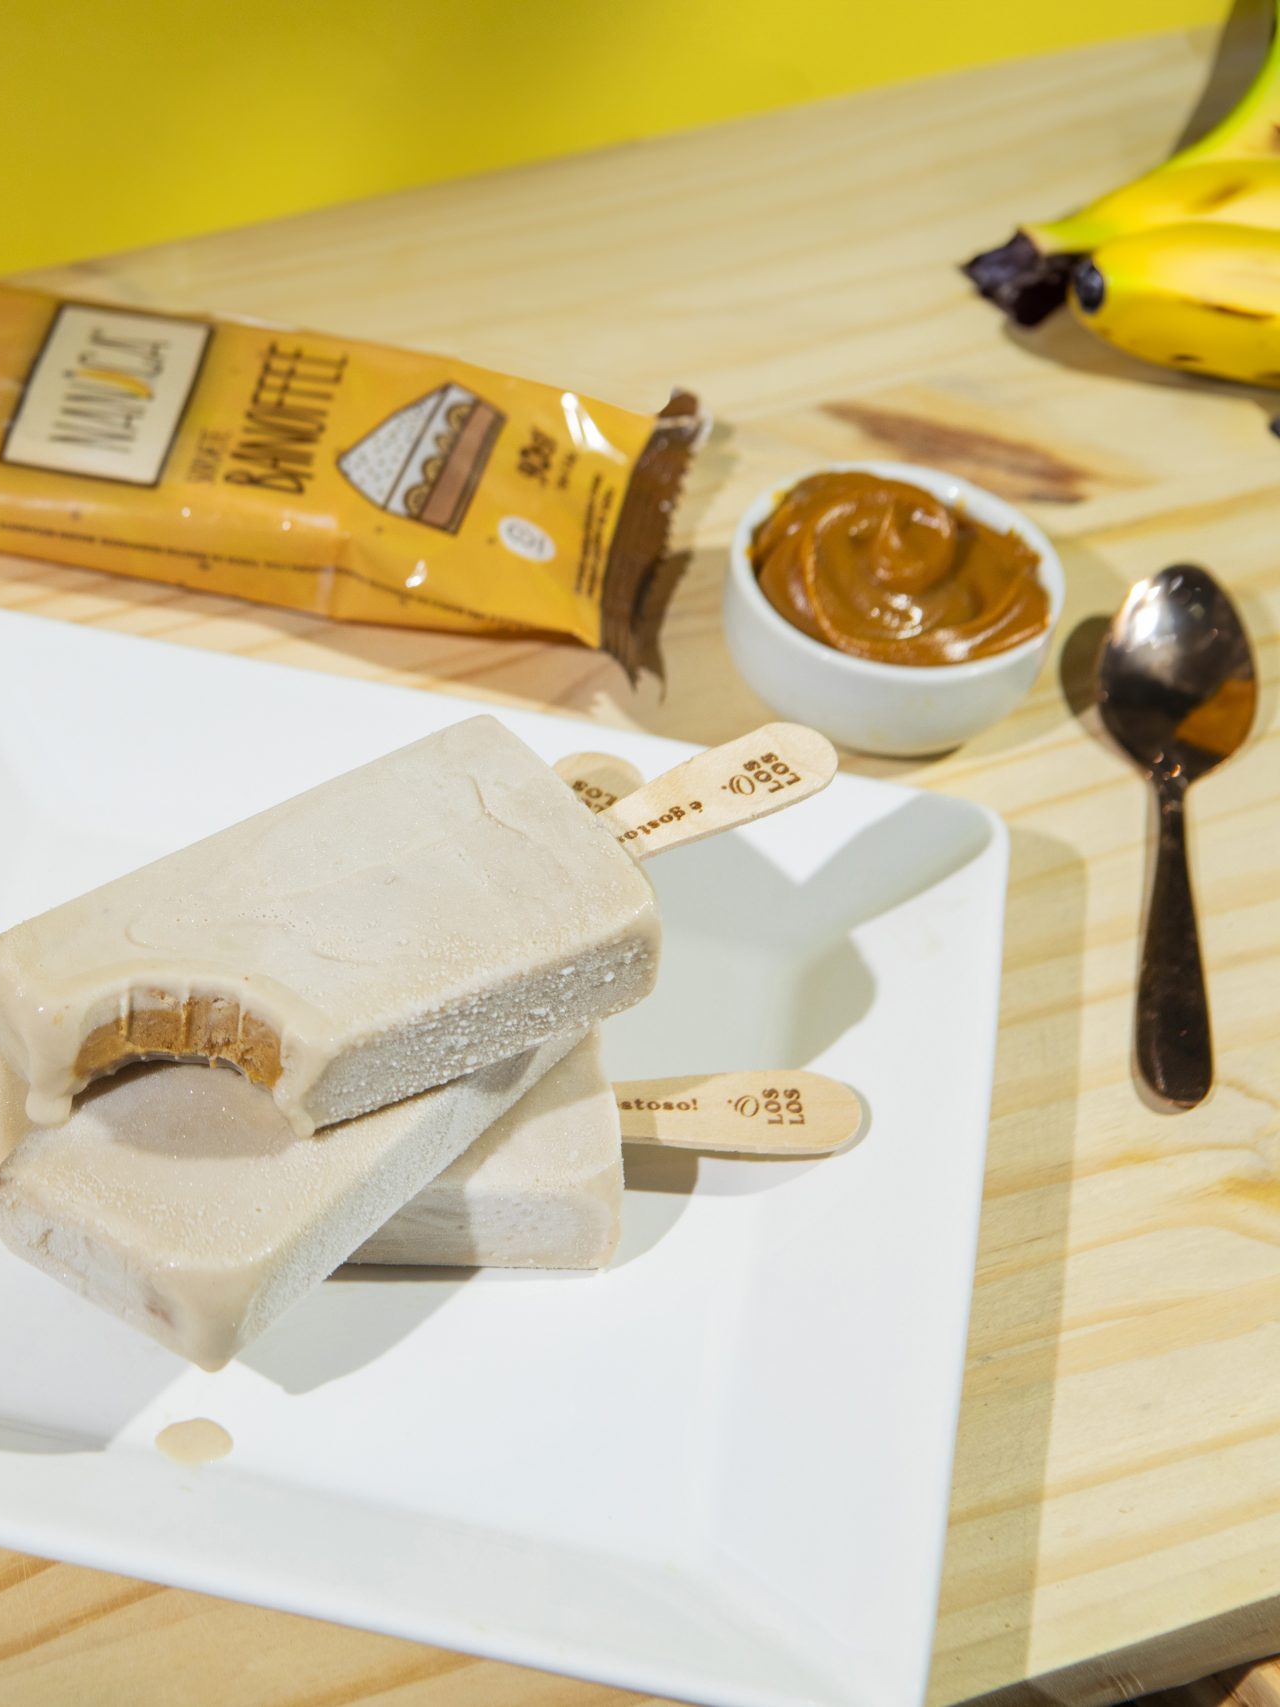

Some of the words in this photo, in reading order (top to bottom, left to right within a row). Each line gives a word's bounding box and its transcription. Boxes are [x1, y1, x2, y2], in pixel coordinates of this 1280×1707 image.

[224, 341, 348, 494] BANOFFEE
[743, 759, 784, 793] LOS
[760, 752, 802, 787] LOS
[616, 1098, 698, 1111] stoso!
[762, 1088, 784, 1125] LOS
[784, 1088, 806, 1126] LOS
